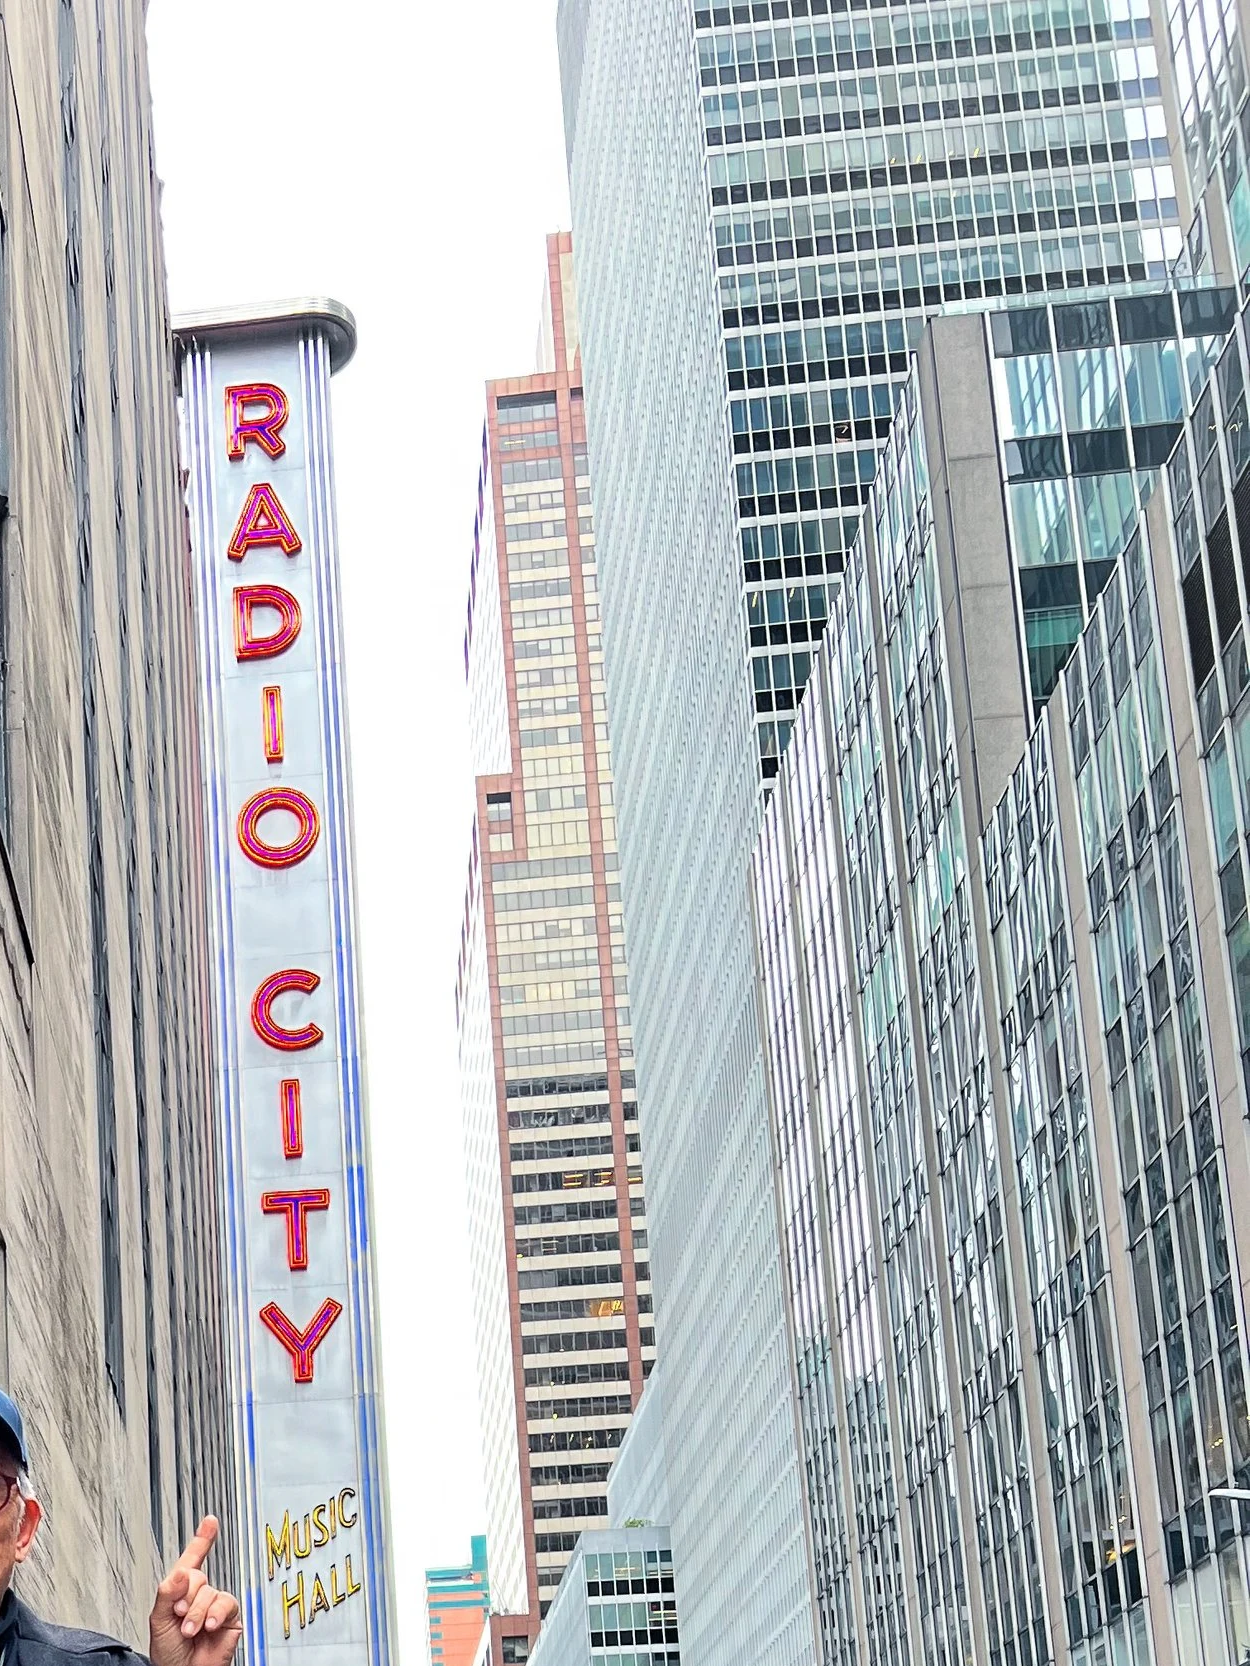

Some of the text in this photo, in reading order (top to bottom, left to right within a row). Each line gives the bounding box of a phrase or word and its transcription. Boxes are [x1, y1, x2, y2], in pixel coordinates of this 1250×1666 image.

[225, 383, 321, 870] RADIO
[250, 968, 343, 1384] CITY
[266, 1487, 357, 1581] MUSIC
[281, 1554, 361, 1639] HALL
